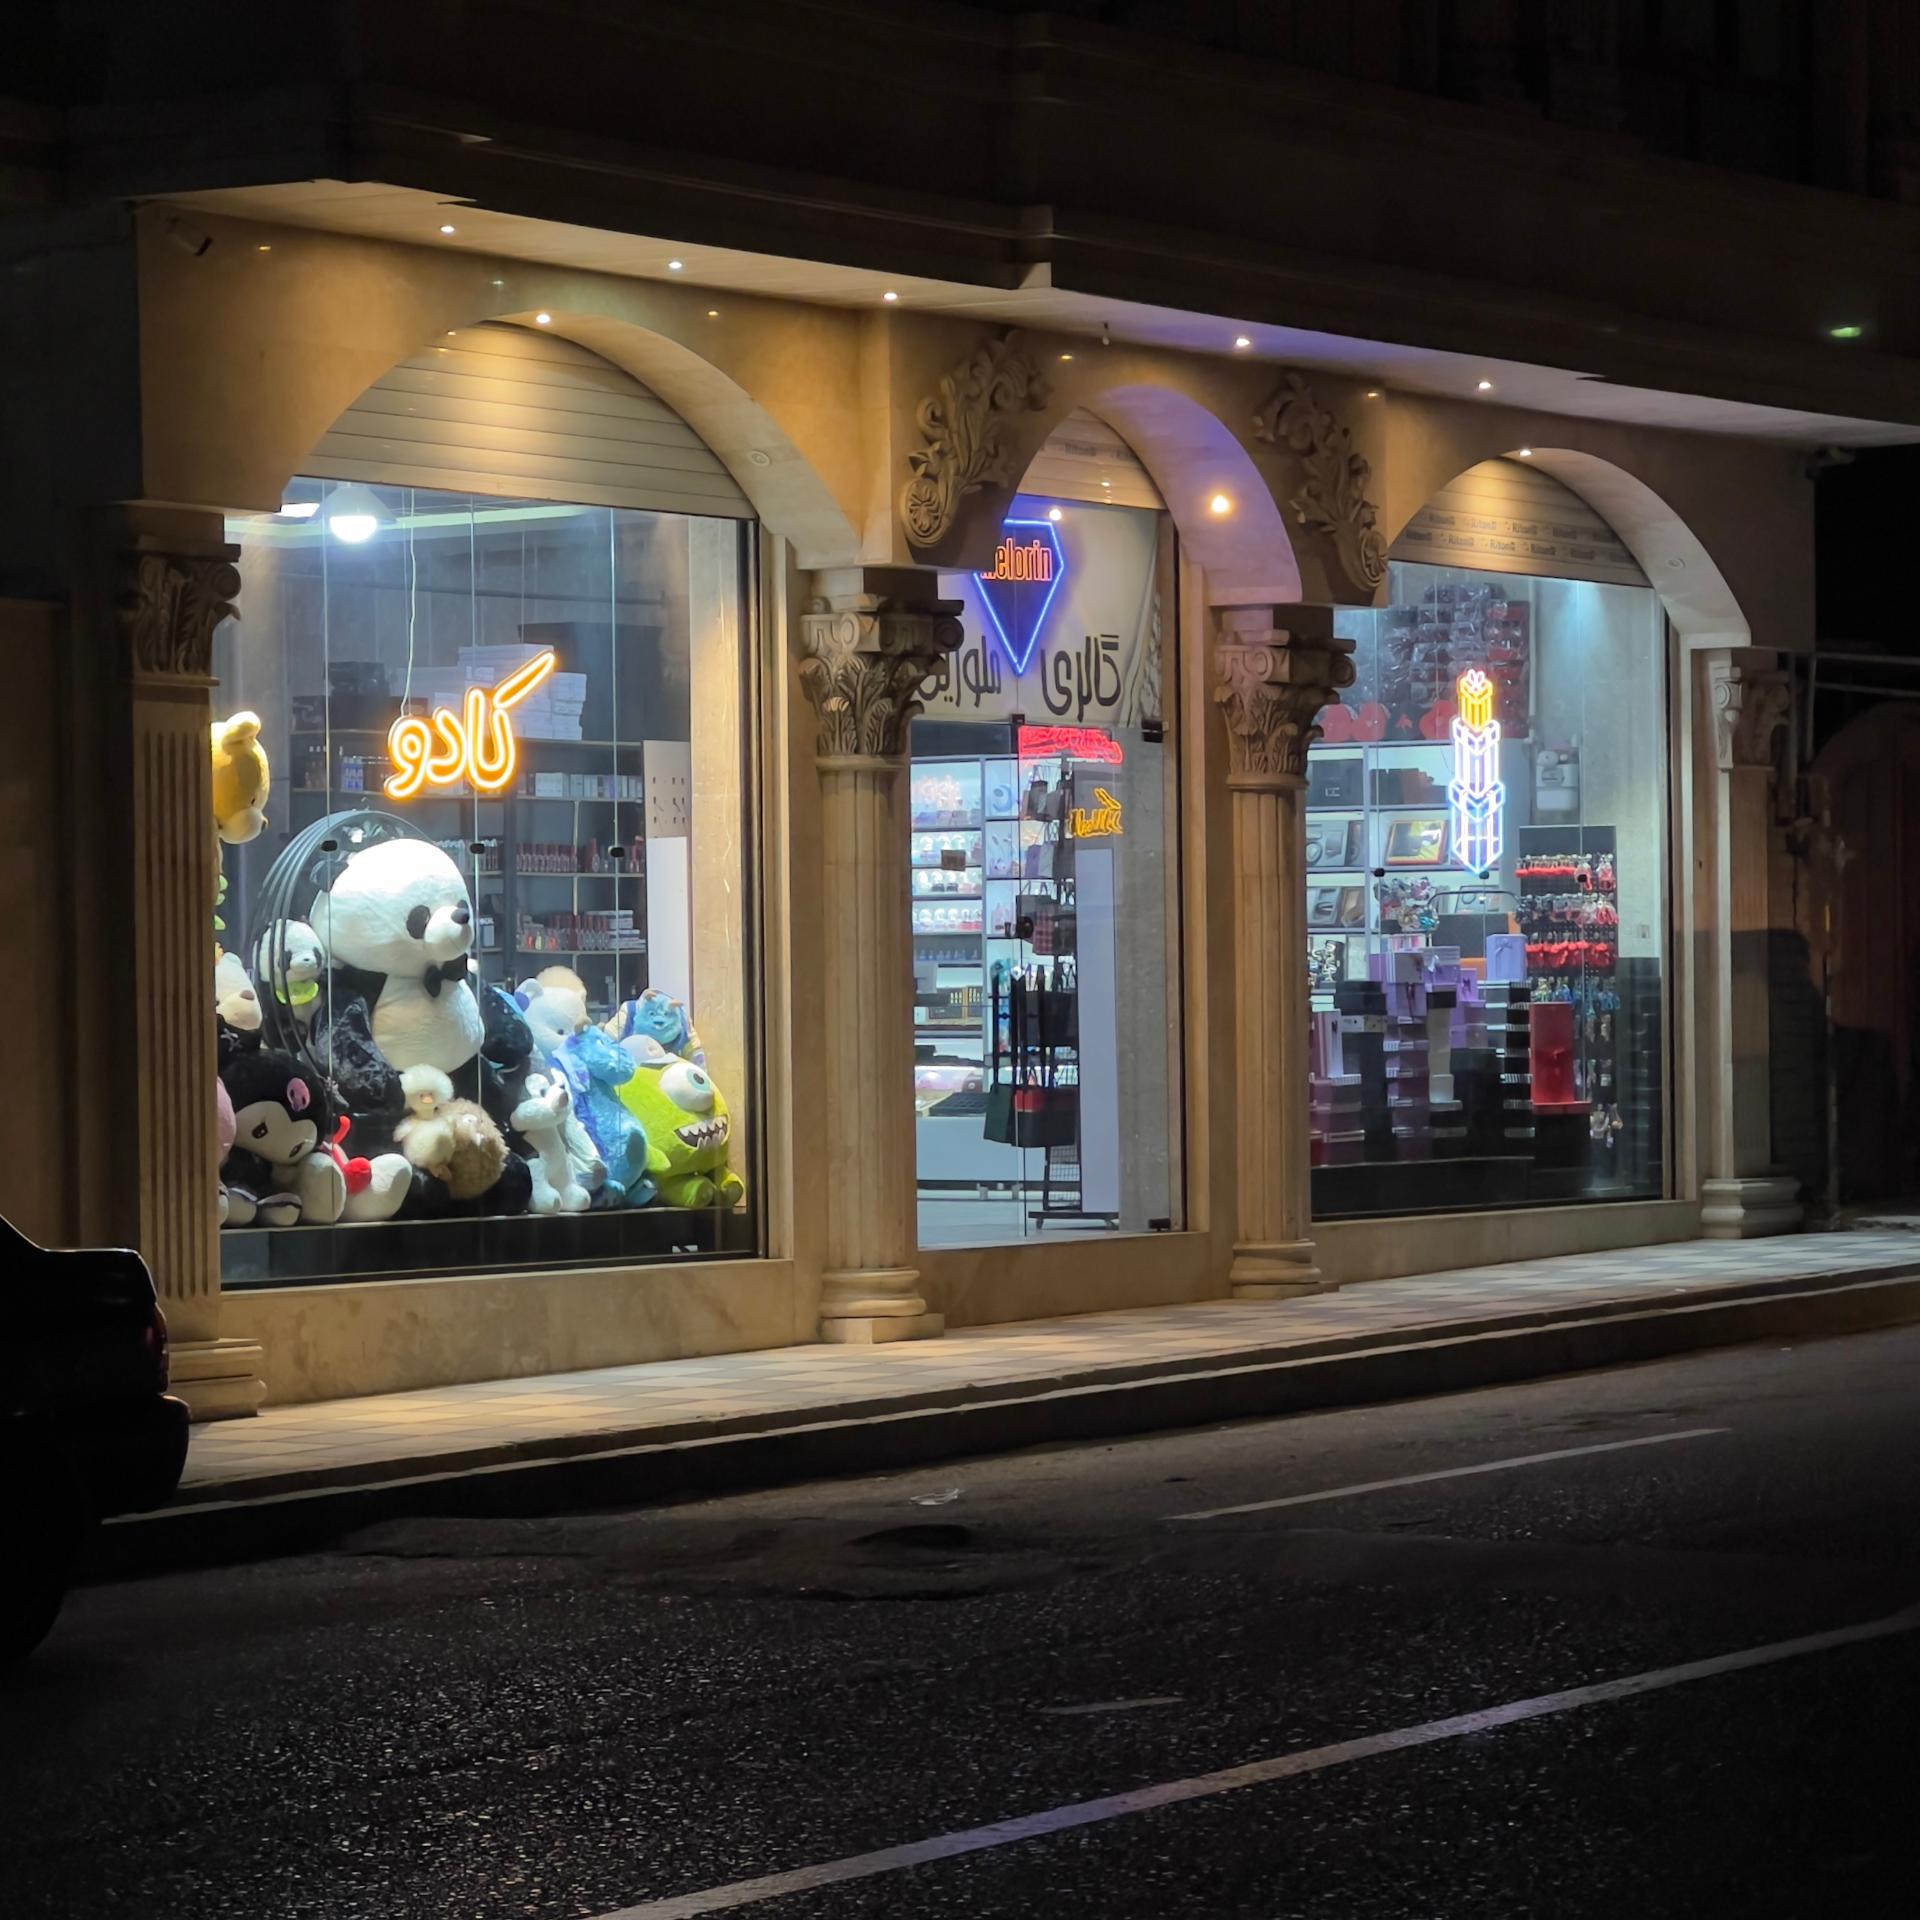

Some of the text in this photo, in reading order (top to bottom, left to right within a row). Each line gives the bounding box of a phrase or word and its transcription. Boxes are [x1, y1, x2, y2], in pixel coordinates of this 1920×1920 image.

[980, 538, 1053, 581] elorin
[1040, 633, 1122, 723] گالری
[384, 649, 557, 801] کادو
